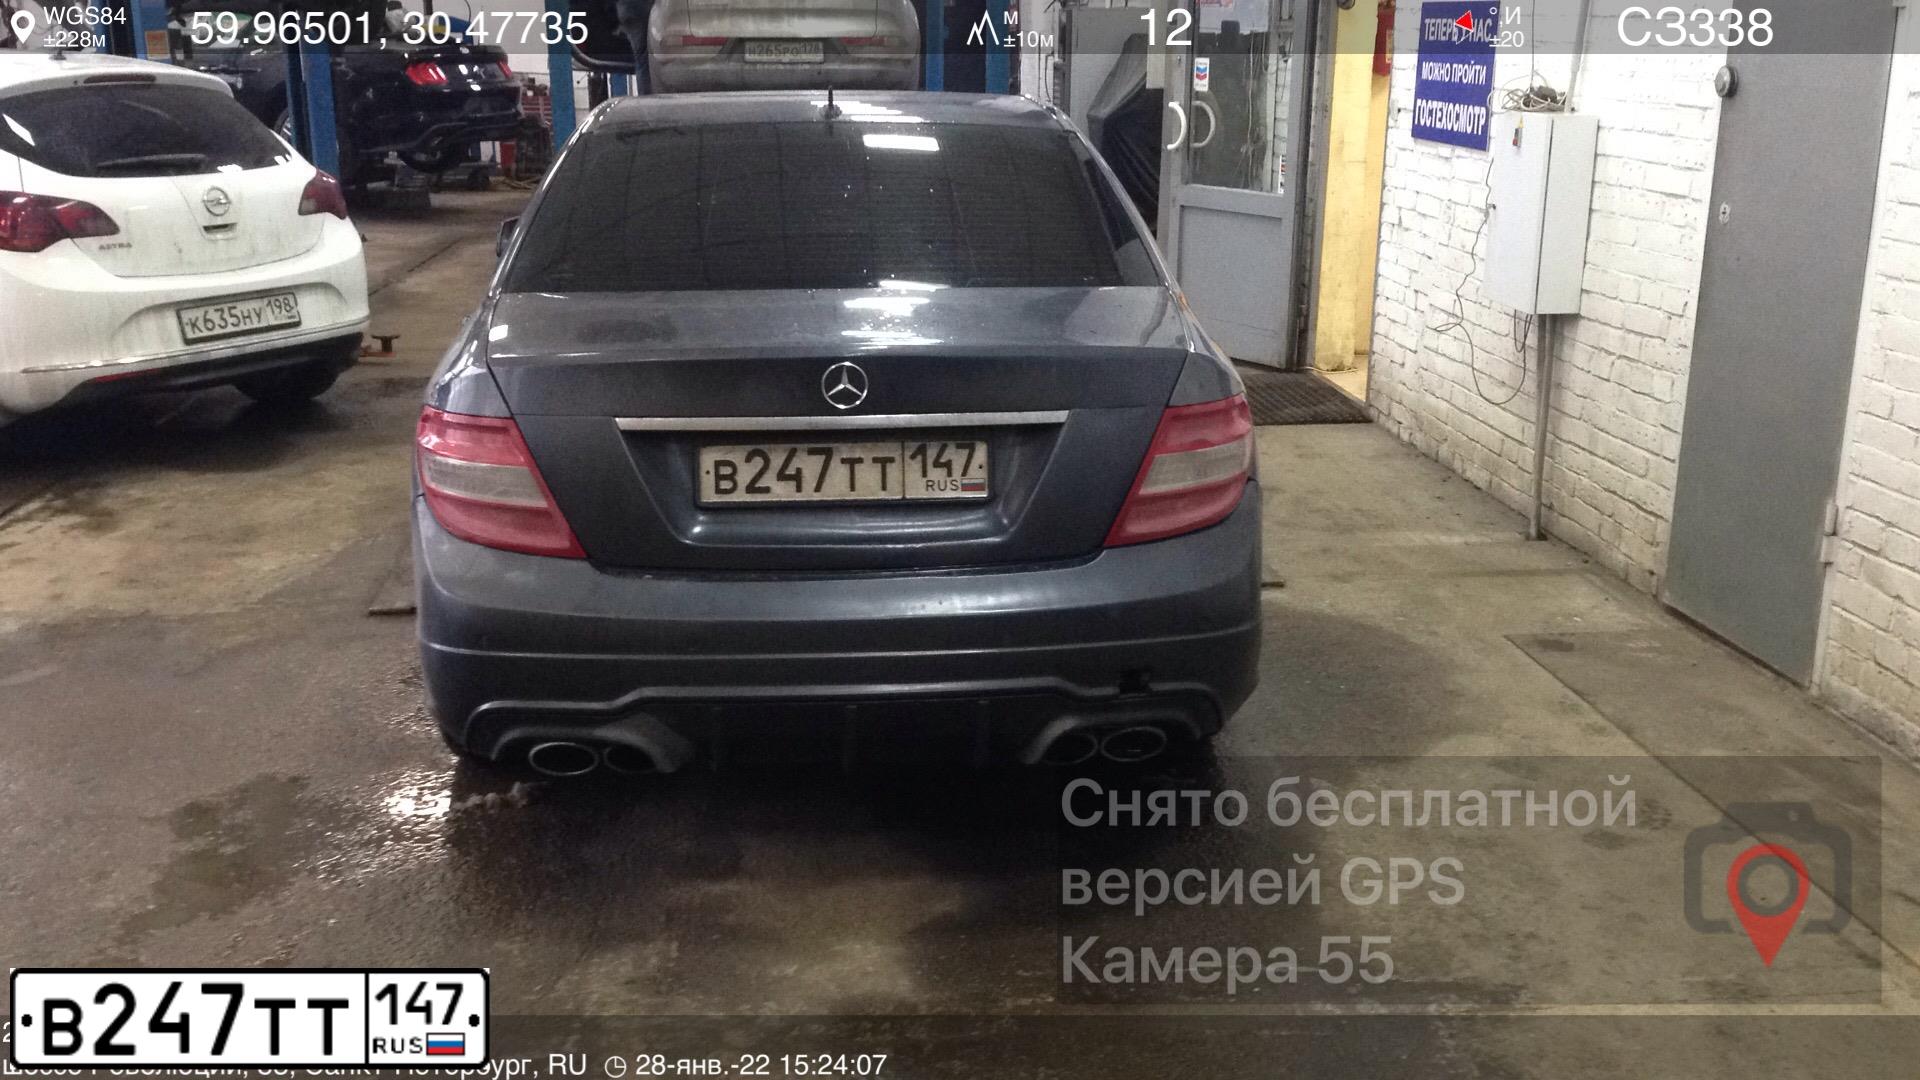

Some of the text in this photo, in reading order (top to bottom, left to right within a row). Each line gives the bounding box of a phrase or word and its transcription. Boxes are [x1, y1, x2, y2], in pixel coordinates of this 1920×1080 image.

[1424, 18, 1459, 42] ТЕПЕРЬ
[1421, 60, 1487, 85] МОЖНО ПРОЙТИ
[1414, 98, 1486, 136] ГОСТЕХОСМОТР
[189, 297, 293, 335] К635НУ 198
[713, 442, 976, 496] В247ТТ 147
[924, 479, 959, 492] RUS
